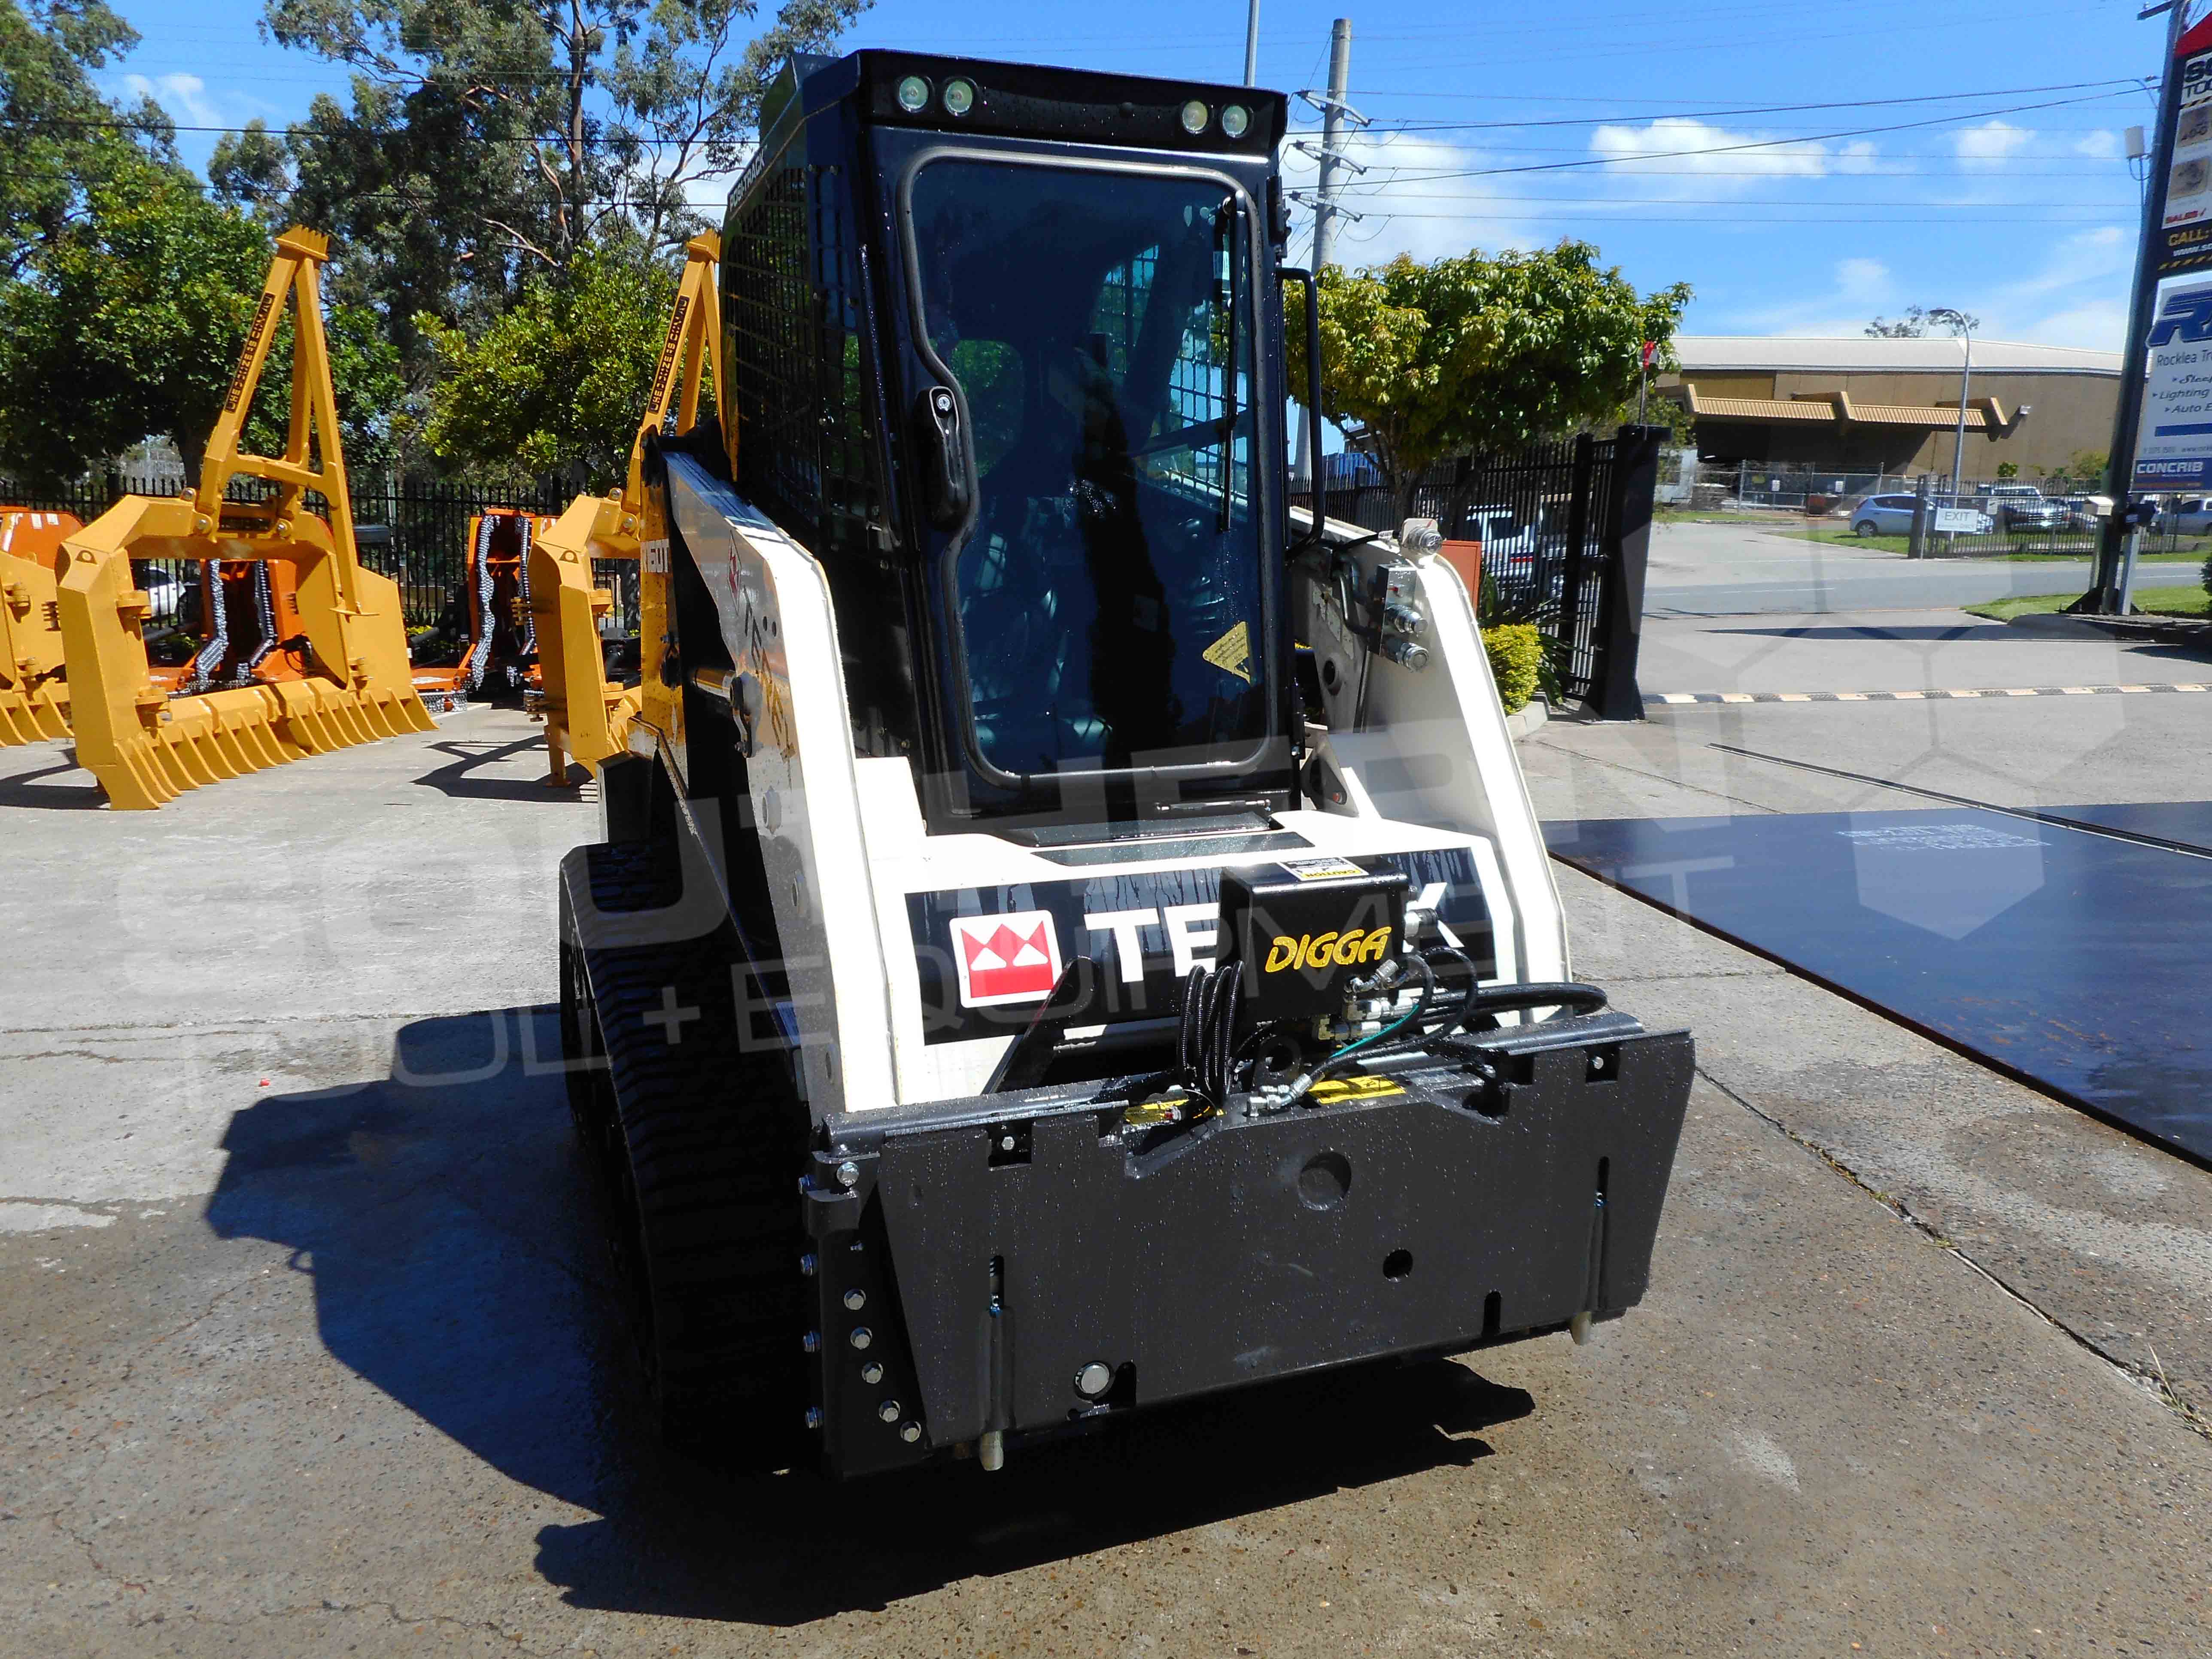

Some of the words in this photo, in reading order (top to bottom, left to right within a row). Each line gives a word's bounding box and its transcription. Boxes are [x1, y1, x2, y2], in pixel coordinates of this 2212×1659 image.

[2157, 352, 2197, 367] Rocklea
[2160, 388, 2210, 401] Lighting
[2171, 404, 2202, 413] Auto
[2136, 461, 2203, 474] CONCRIB
[1944, 511, 1971, 521] EXIT
[1265, 925, 1392, 973] DIGGA
